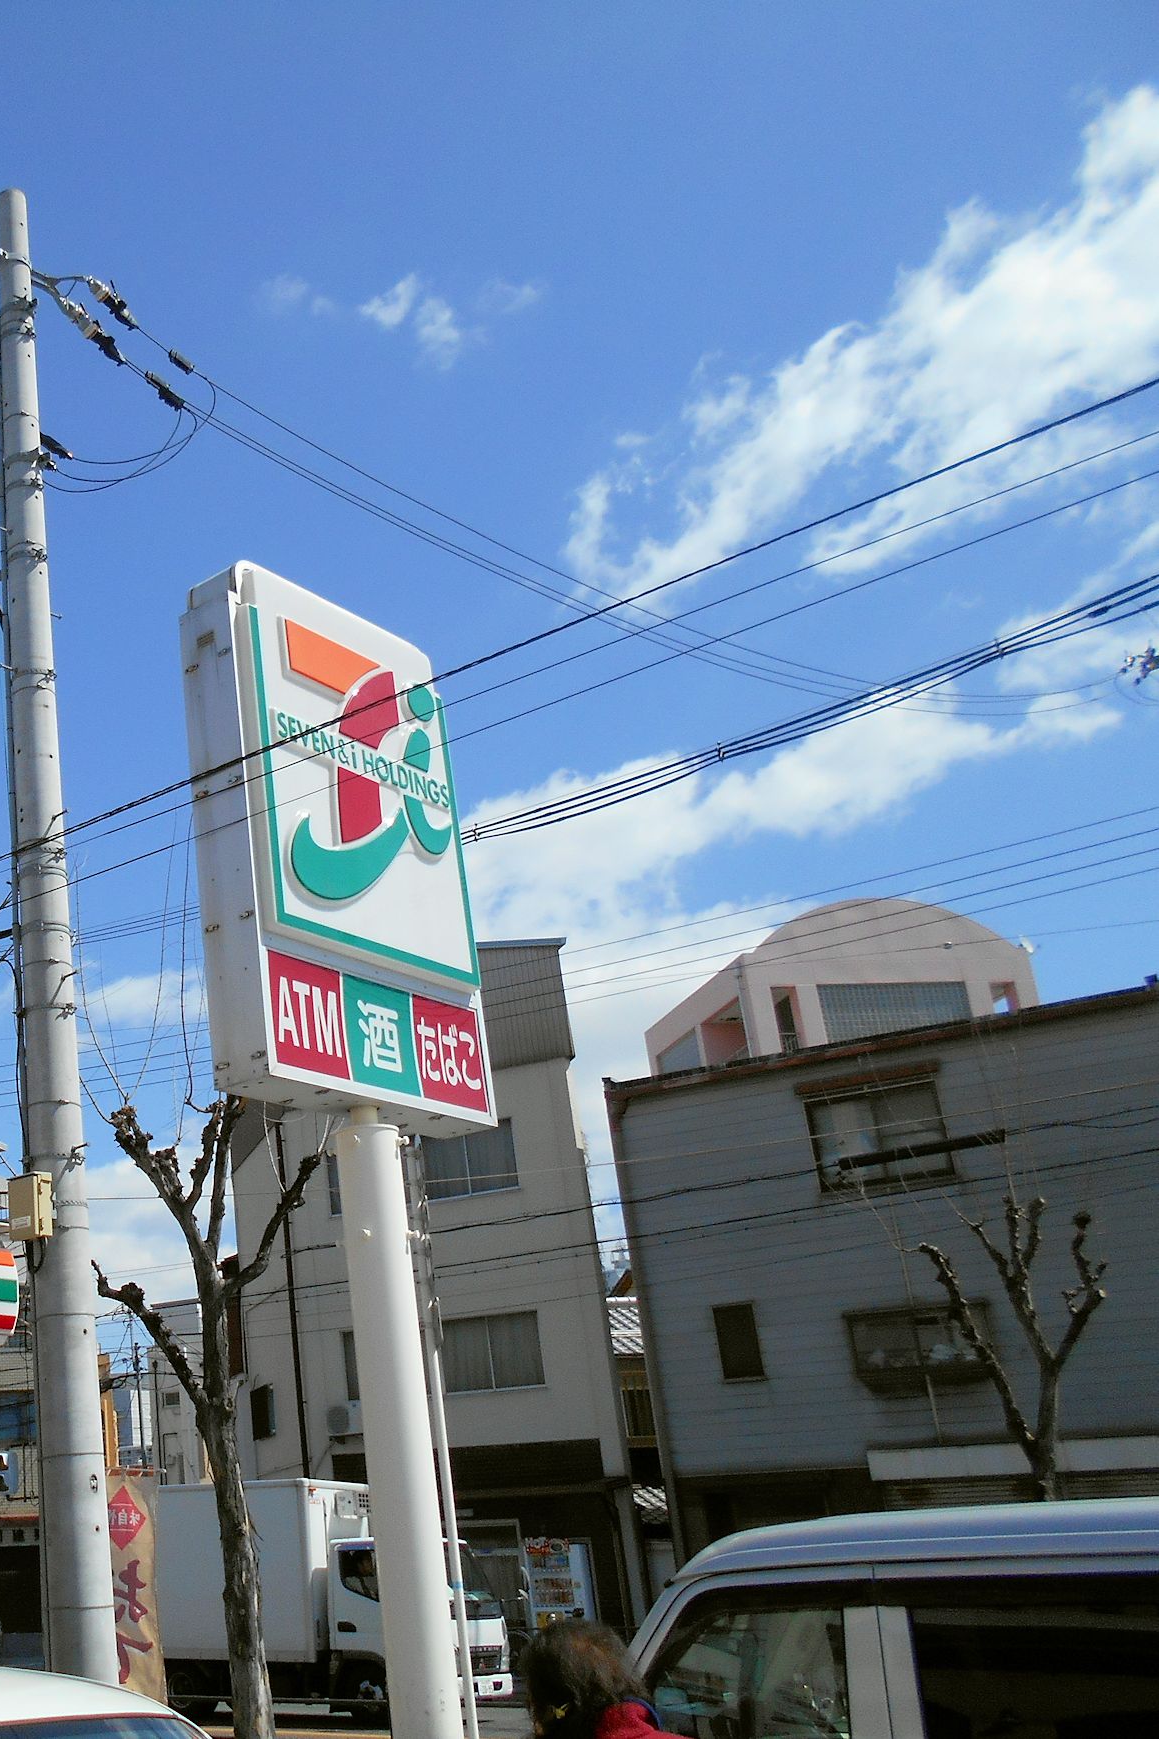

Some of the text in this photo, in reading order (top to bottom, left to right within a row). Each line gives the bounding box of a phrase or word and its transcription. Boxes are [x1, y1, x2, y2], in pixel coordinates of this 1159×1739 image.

[362, 749, 450, 809] HOLDINGS
[278, 976, 343, 1058] ATM
[357, 1000, 402, 1073] 酒
[417, 1016, 482, 1090] たばこ
